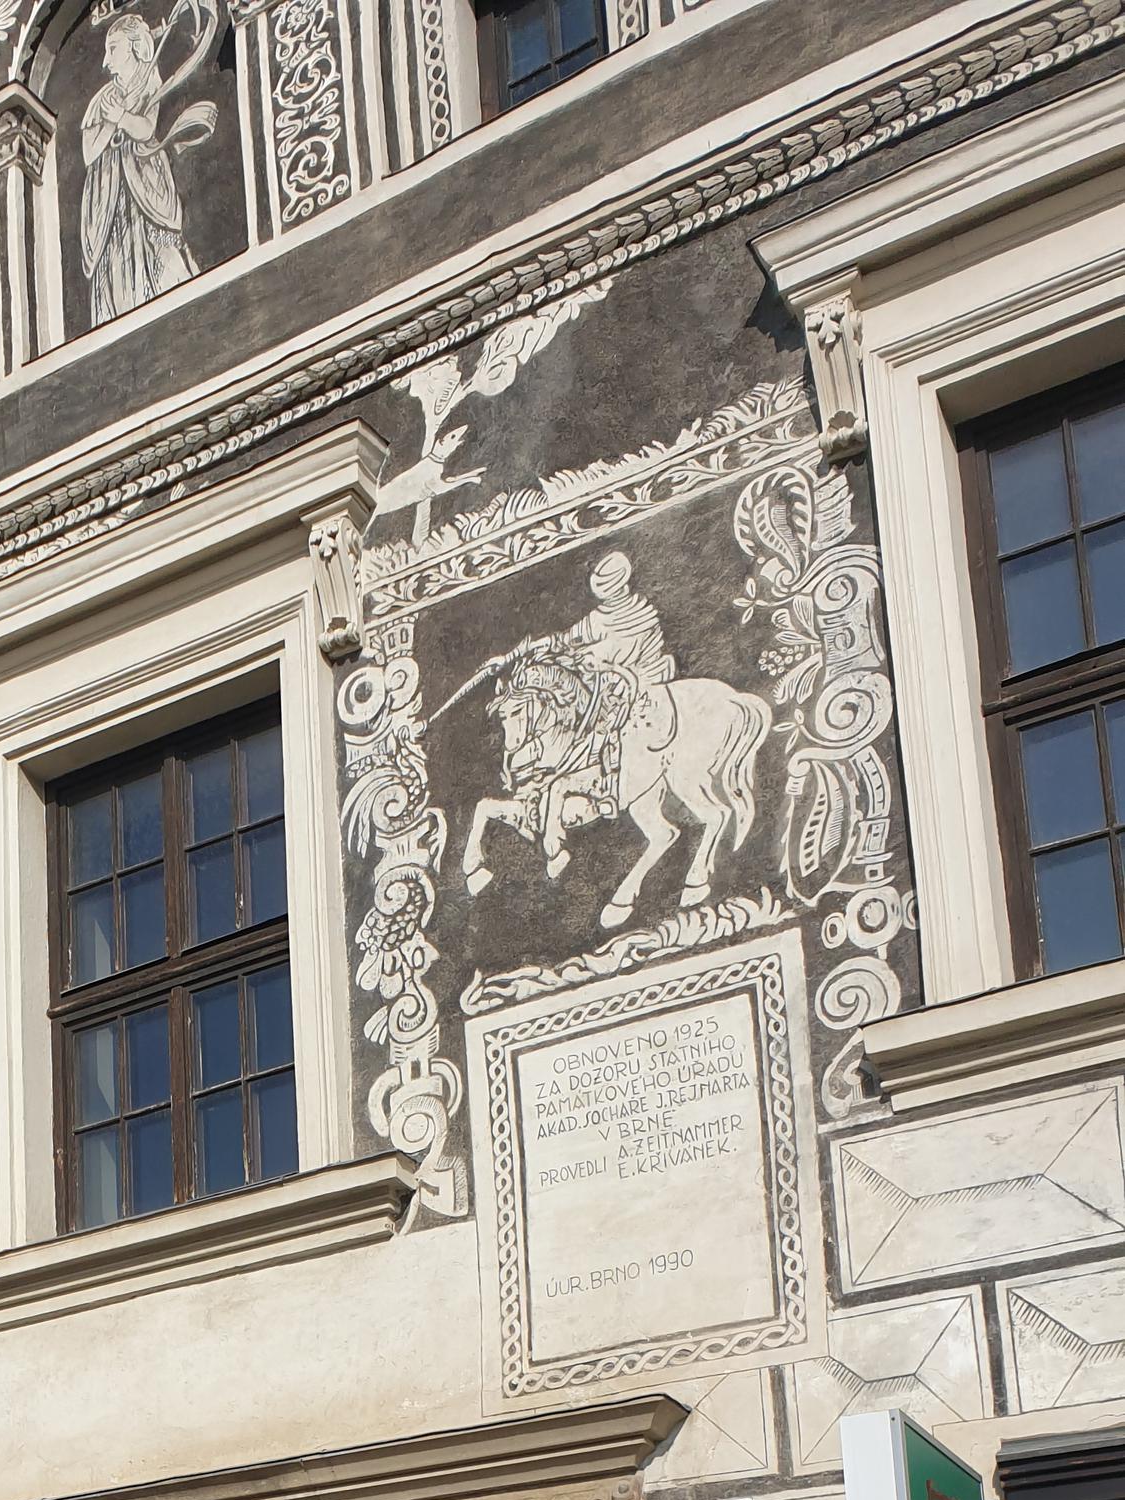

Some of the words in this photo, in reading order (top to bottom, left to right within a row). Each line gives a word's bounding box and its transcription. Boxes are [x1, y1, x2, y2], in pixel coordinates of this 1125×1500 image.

[553, 1030, 667, 1075] OBNOVENO
[676, 1016, 719, 1042] 1925
[536, 1080, 562, 1100] ZA
[569, 1060, 641, 1092] DOZORU
[598, 1127, 611, 1142] V
[539, 1157, 607, 1187] PROVEDLI
[649, 1249, 694, 1276] 1990
